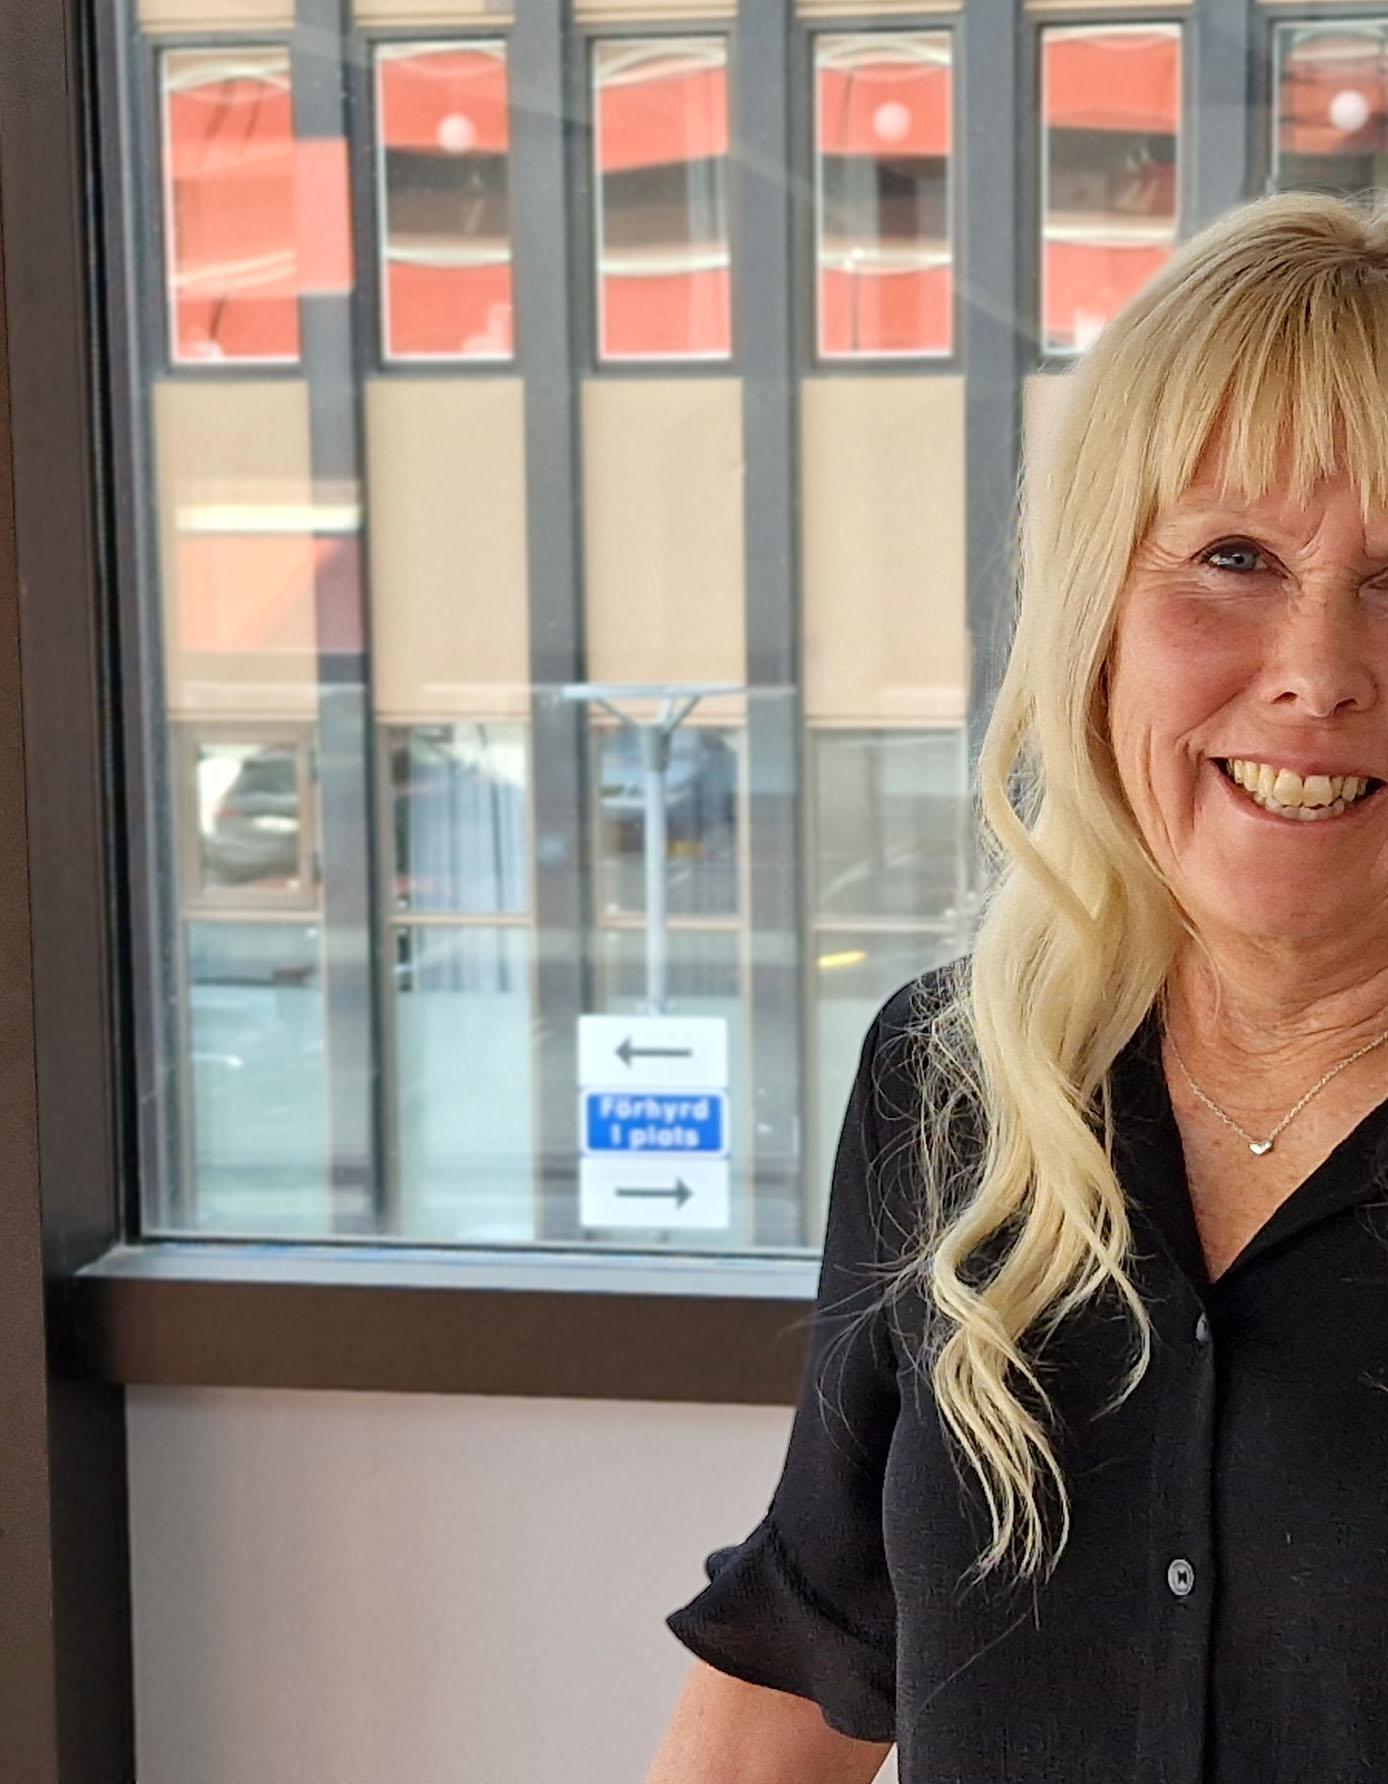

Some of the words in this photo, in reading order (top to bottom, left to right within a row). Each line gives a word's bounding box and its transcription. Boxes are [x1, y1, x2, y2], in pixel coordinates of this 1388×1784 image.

[600, 1095, 709, 1124] Förhyrd
[610, 1123, 621, 1146] 1
[629, 1124, 700, 1150] plats
